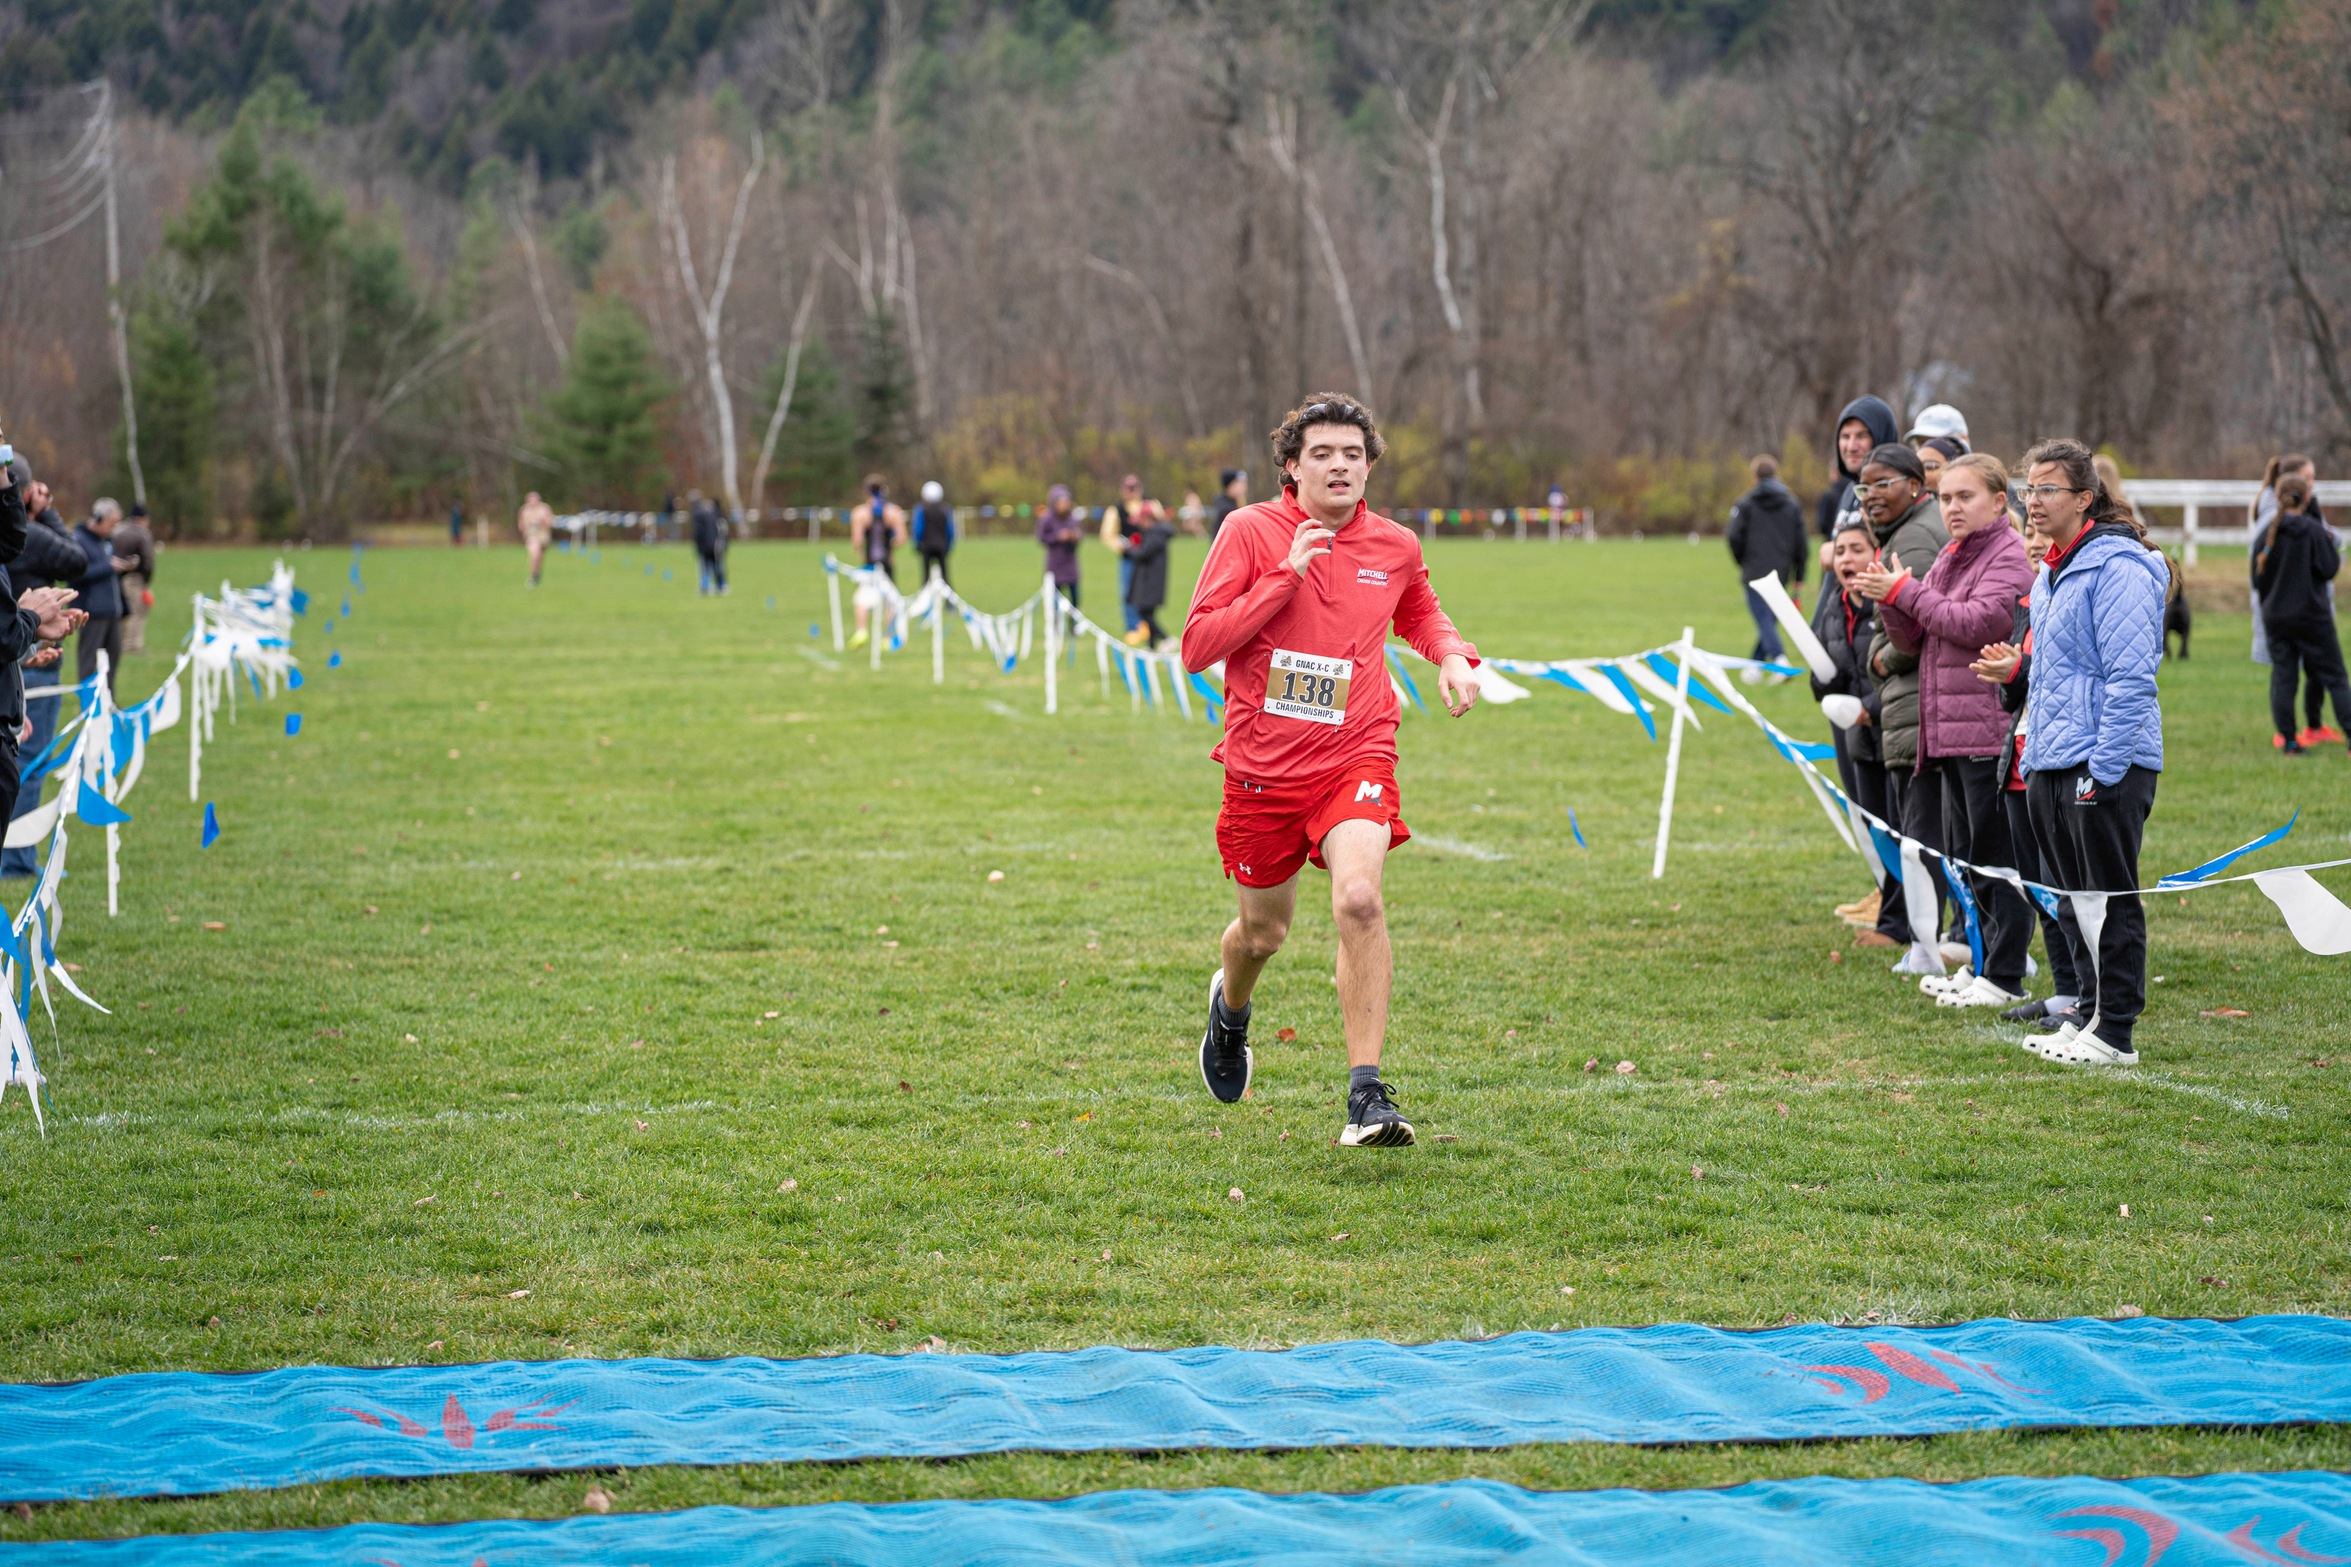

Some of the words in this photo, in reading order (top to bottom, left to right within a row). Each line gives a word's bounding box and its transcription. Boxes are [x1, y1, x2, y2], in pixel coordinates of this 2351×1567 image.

[1357, 568, 1388, 580] MITCHELL
[1296, 659, 1316, 671] GNAC
[1316, 663, 1330, 673] X-C
[1281, 671, 1336, 708] 138
[1275, 701, 1335, 719] CHAMPIONSHIPS
[1354, 780, 1383, 802] M
